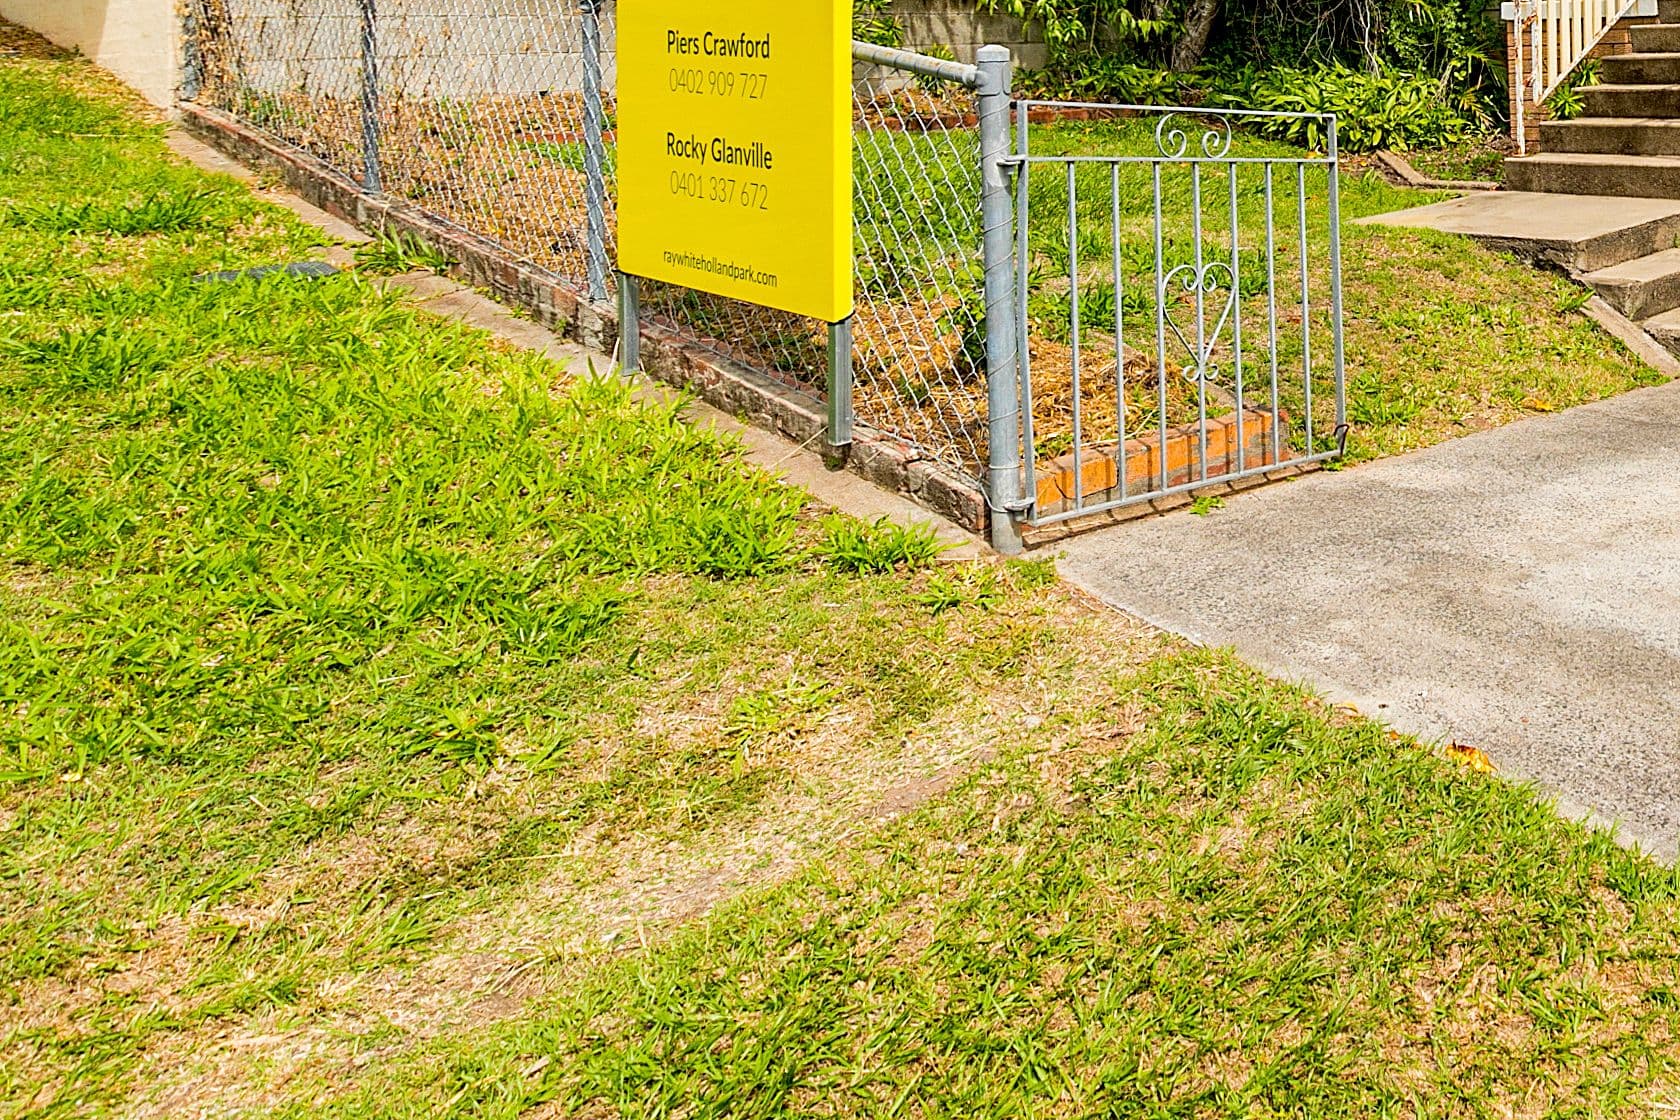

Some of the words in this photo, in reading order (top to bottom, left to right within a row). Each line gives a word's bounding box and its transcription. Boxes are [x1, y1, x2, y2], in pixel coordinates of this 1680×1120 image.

[667, 30, 699, 55] Piers
[704, 31, 770, 59] Crawford
[669, 68, 703, 94] 0402
[709, 71, 734, 97] 909
[740, 73, 767, 99] 727
[667, 132, 706, 163] Rocky
[712, 137, 772, 169] Glanville
[670, 170, 704, 199] 0401
[709, 176, 736, 203] 337
[741, 182, 768, 210] 672
[663, 249, 778, 287] raywhitehollandpark.com
